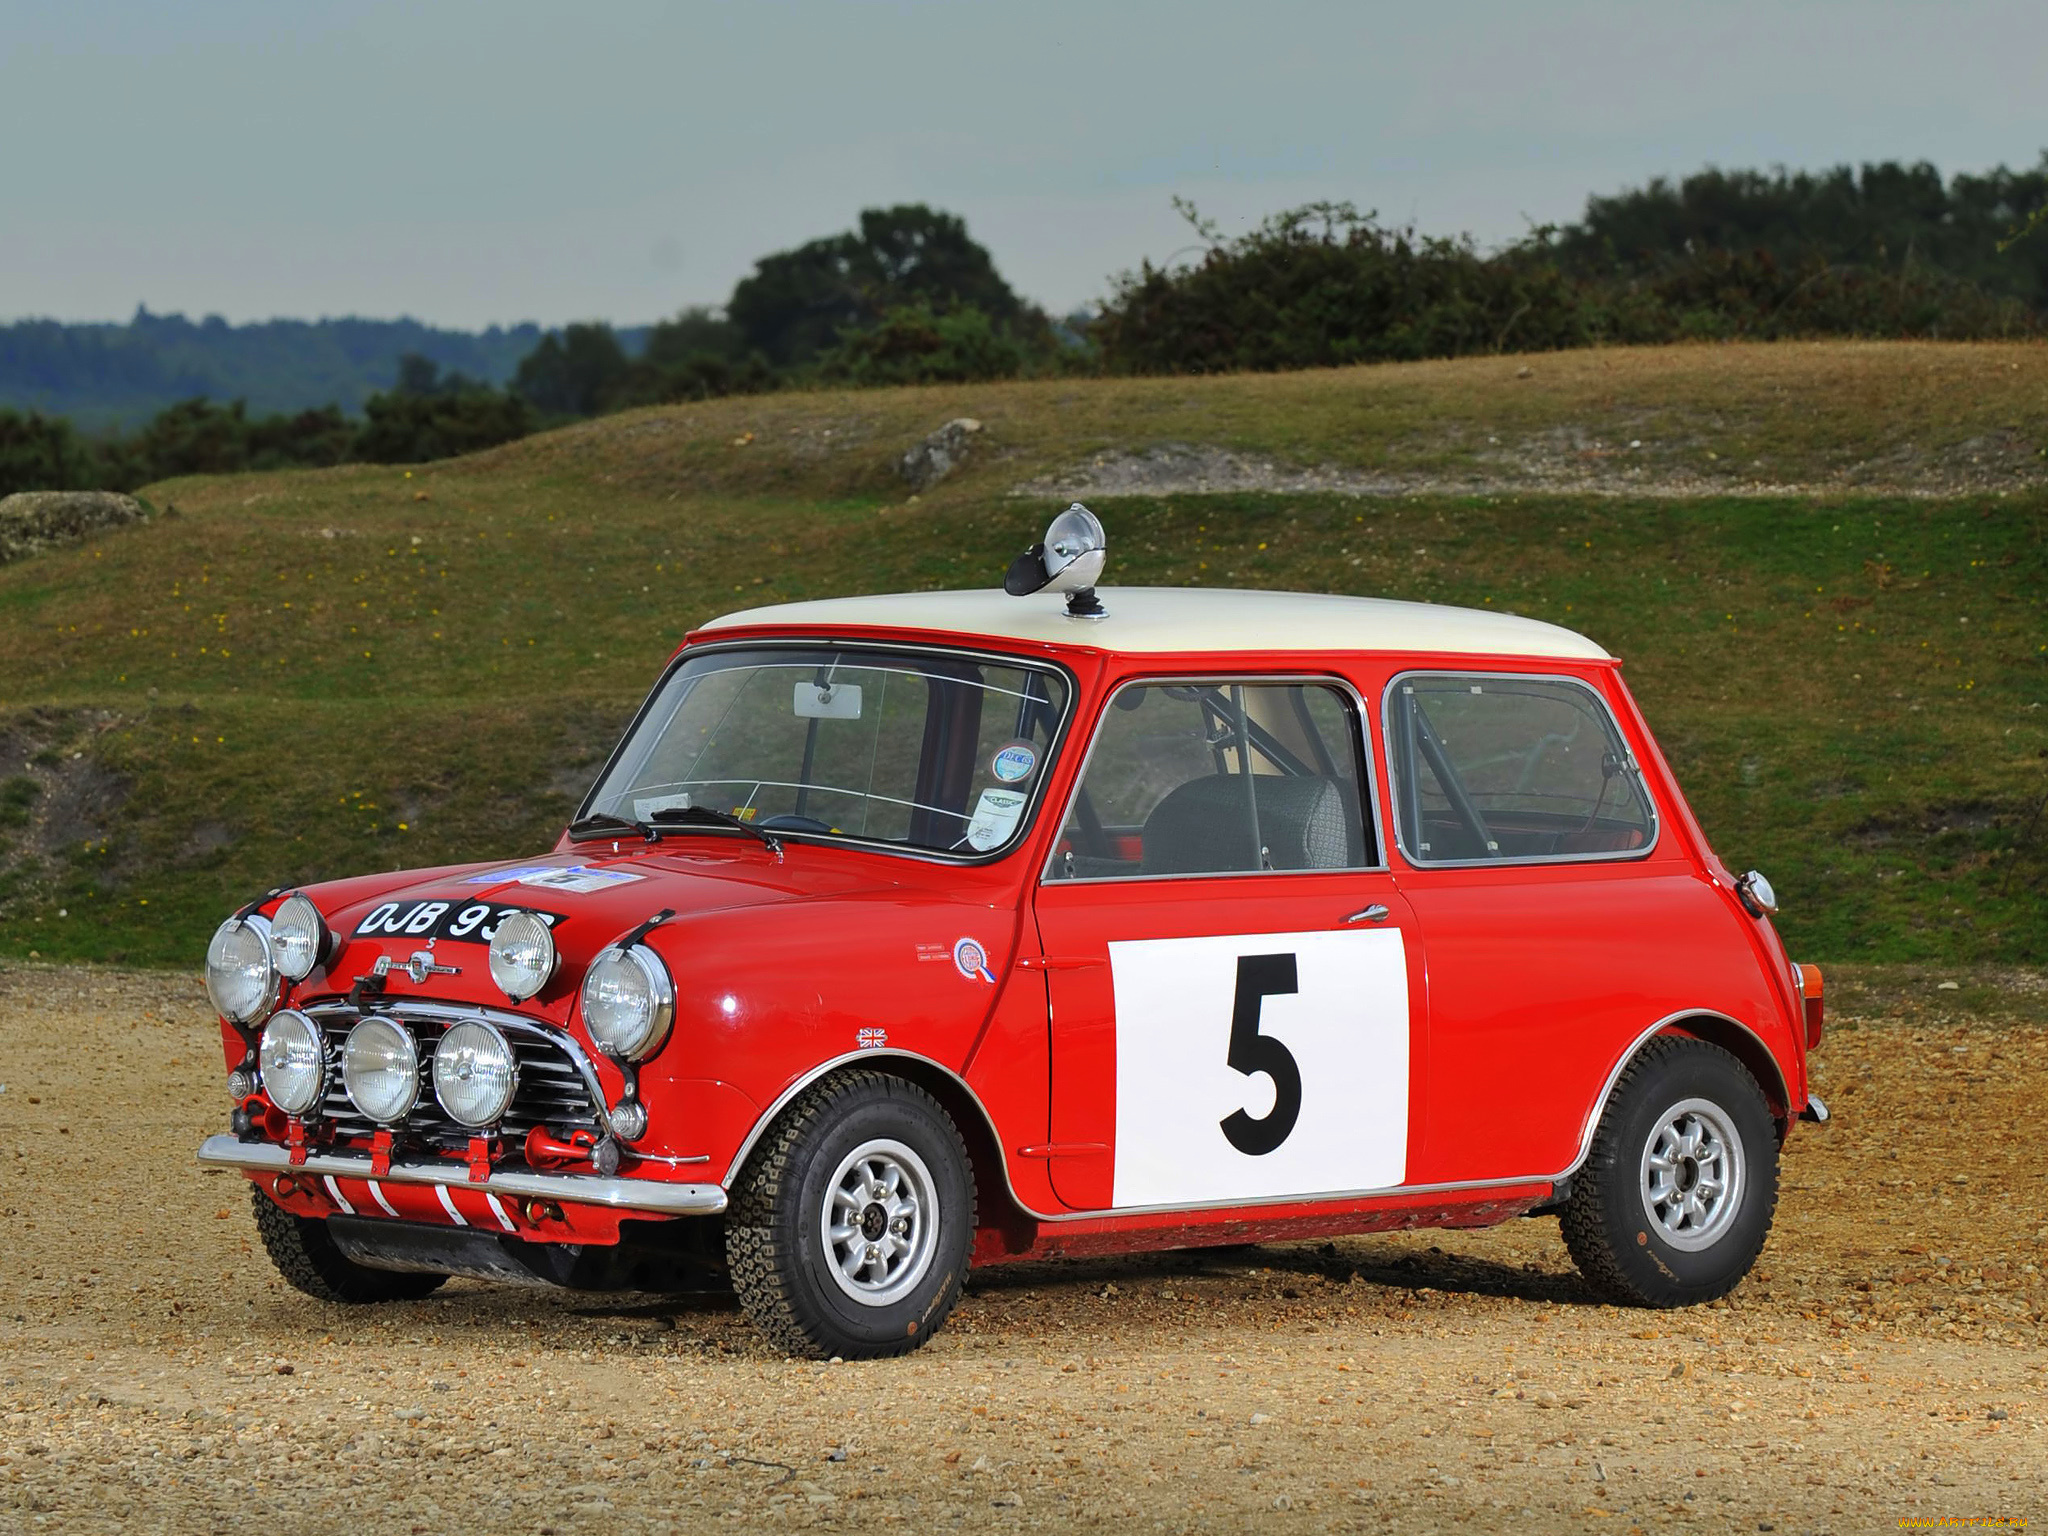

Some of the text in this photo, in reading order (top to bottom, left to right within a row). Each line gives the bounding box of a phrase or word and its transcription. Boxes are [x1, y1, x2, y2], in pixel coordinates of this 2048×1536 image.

[356, 902, 555, 940] DJB 93
[426, 937, 437, 949] S
[1219, 952, 1302, 1156] 5
